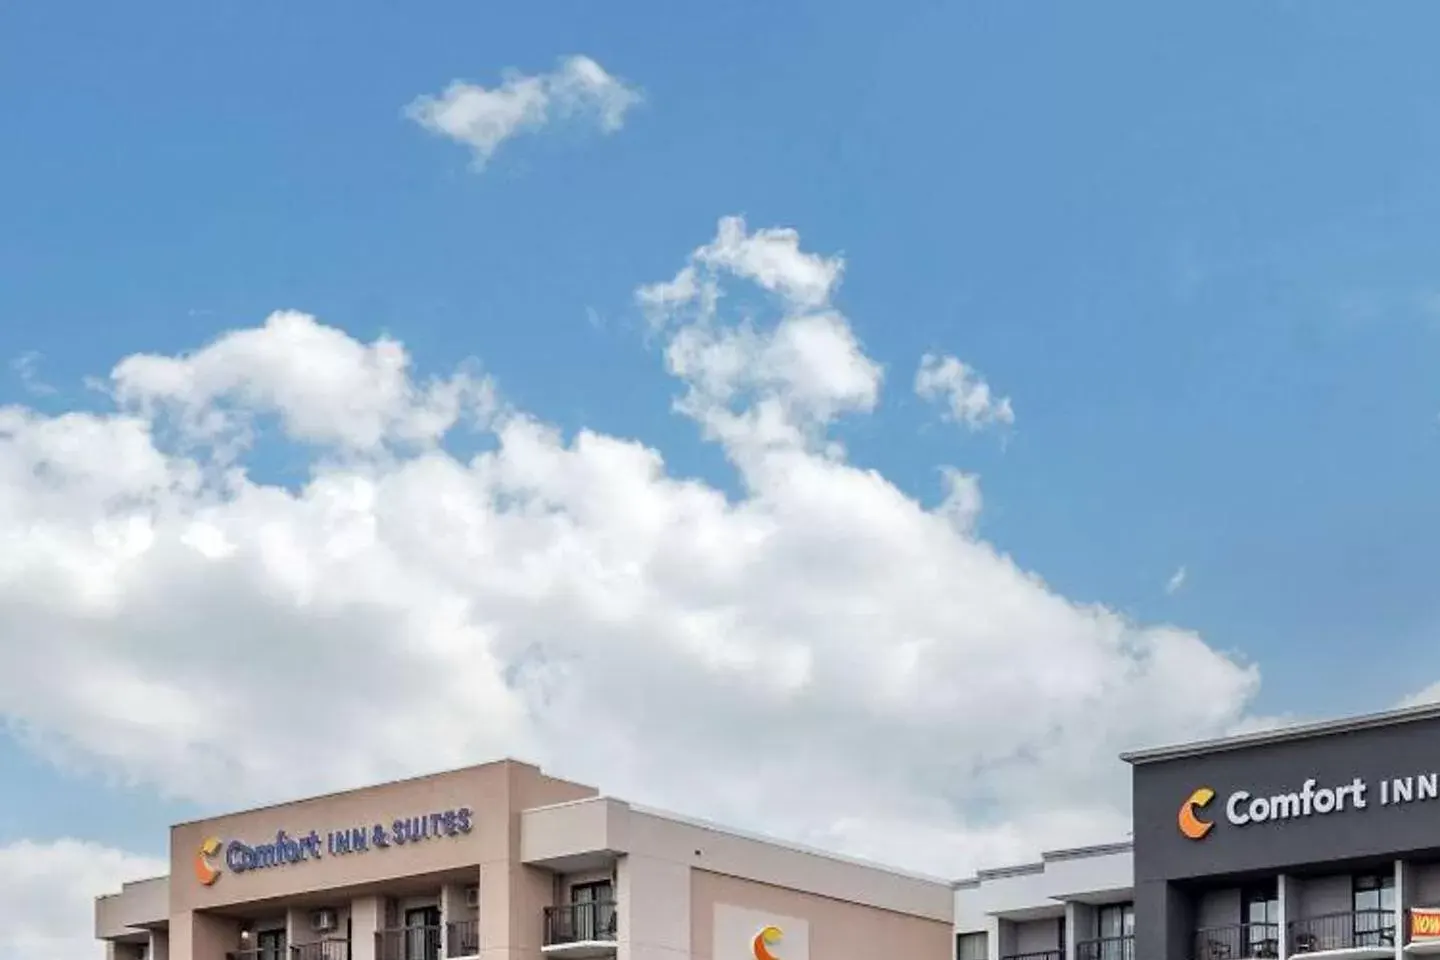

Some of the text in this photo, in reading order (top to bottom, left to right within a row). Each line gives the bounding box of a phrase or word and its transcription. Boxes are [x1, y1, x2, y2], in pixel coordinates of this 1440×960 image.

[1225, 776, 1367, 826] Comfort
[1380, 772, 1438, 805] INN
[226, 829, 322, 874] Comfort
[327, 826, 369, 856] INN
[372, 823, 390, 849] &
[392, 807, 474, 846] SUITES
